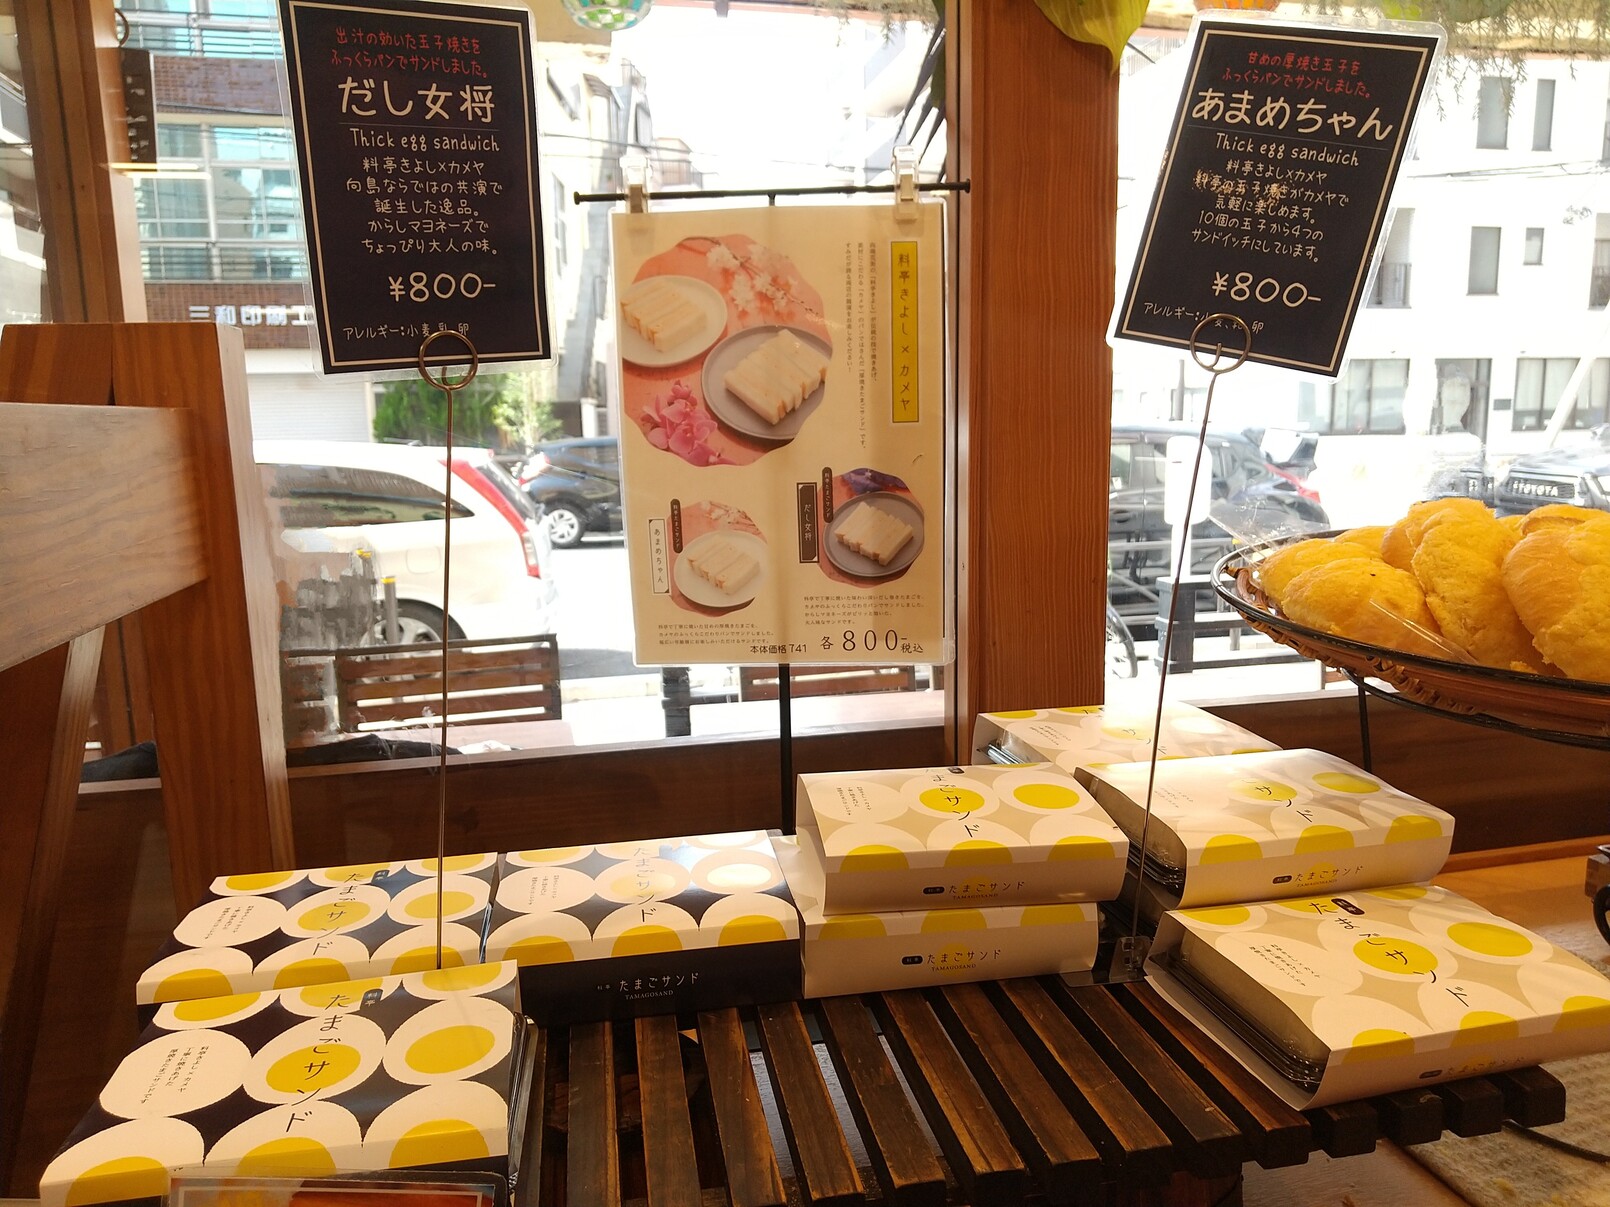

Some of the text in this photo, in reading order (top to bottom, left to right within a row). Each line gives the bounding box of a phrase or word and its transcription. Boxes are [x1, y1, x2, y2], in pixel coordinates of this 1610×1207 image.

[335, 26, 481, 55] 出汁の効いた玉子焼きを
[331, 50, 488, 79] ふっくらパンでサンドしました。
[1247, 51, 1361, 76] 甘めの厚焼き玉子を
[1222, 67, 1372, 99] ふっくらパンでサンドしました。
[338, 76, 496, 123] だし女将
[1191, 87, 1394, 141] あまめちゃん
[350, 128, 500, 152] Thick egg sandwich
[1216, 132, 1360, 167] Thick egg sandwich
[346, 176, 503, 196] 向島ならではの共演で
[374, 198, 479, 217] 誕生した逸品。
[1214, 194, 1316, 225] 気軽に楽しめます。
[367, 218, 489, 235] からしマヨネーズで
[1198, 209, 1325, 241] 10個の玉子から4つの
[361, 238, 498, 256] ちょっぴり大人の味。
[1191, 228, 1320, 263] サンドイッチにしています。
[897, 253, 911, 412] 料亭きよし×カメヤ
[803, 504, 812, 541] だし女将
[654, 528, 664, 584] あまめちゃん
[750, 643, 808, 654] 本体価格 741
[820, 635, 835, 650] 各
[901, 642, 924, 654] 税込
[948, 881, 1025, 895] たまごサンド
[312, 872, 365, 956] たまごサンド
[927, 949, 1002, 964] たまごサンド
[1308, 902, 1470, 1008] たまごサンド
[619, 972, 699, 992] たまごサンド
[625, 989, 674, 1000] TAMAGOSAND
[284, 993, 350, 1134] たまごサンド
